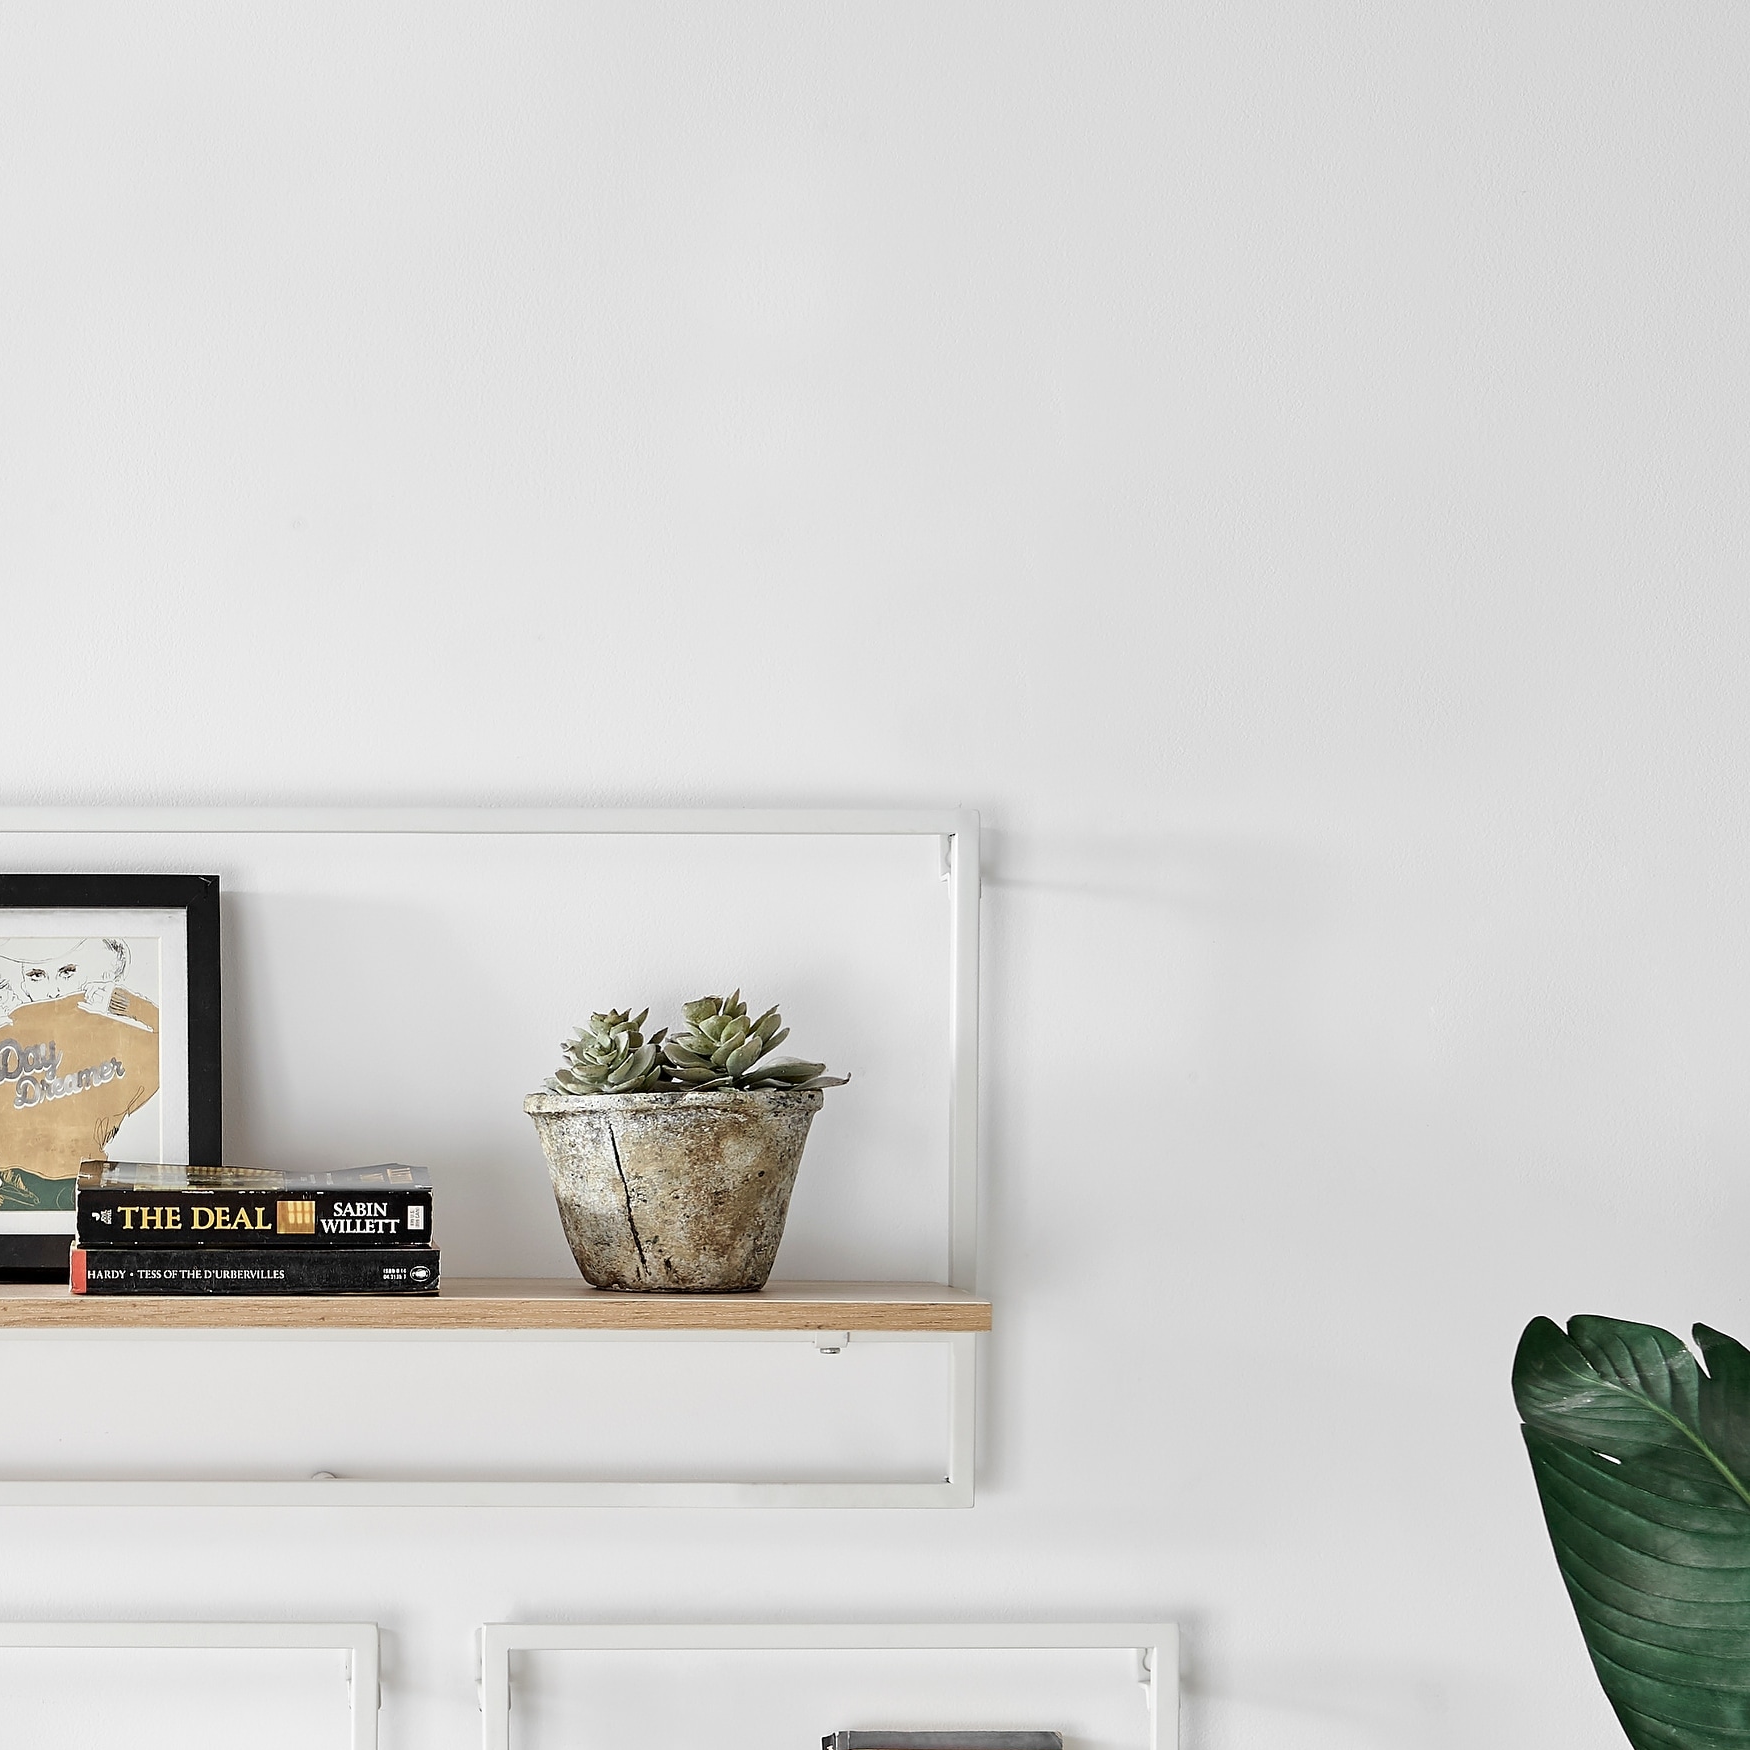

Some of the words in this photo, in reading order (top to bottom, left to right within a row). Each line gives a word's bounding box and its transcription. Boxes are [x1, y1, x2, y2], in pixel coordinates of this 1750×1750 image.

[13, 1057, 125, 1109] Dreamer
[333, 1202, 388, 1217] SABIN
[117, 1206, 182, 1230] THE
[191, 1206, 272, 1230] DEAL
[320, 1219, 400, 1234] WILLETT
[87, 1270, 126, 1279] HARDY
[137, 1270, 162, 1279] TESS
[163, 1270, 178, 1279] OF
[179, 1270, 202, 1279] THE
[204, 1270, 285, 1279] D'URBERVILLES
